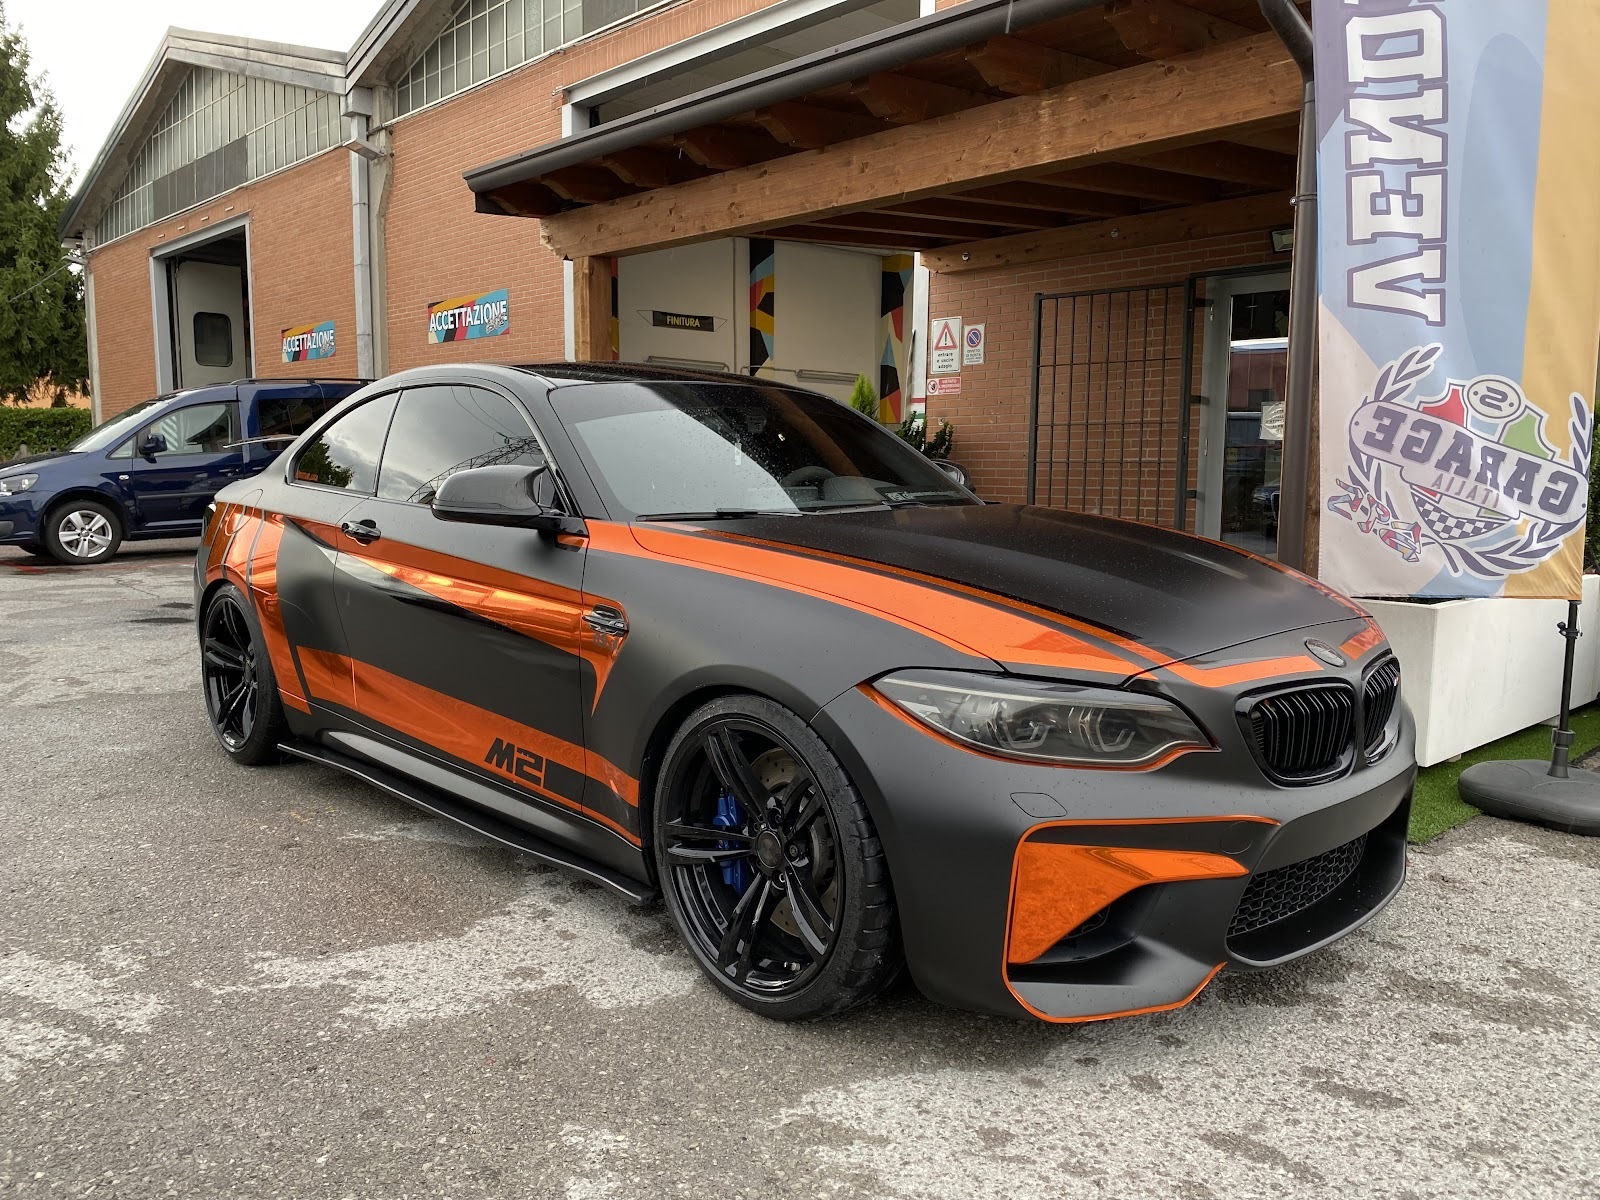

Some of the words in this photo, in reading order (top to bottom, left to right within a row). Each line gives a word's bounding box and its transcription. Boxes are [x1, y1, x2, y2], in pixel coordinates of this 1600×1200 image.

[429, 300, 508, 332] ACCETTAZIONE
[666, 315, 701, 328] FINITURA
[282, 329, 335, 352] ACCETTAZIONE
[484, 737, 544, 787] M2
